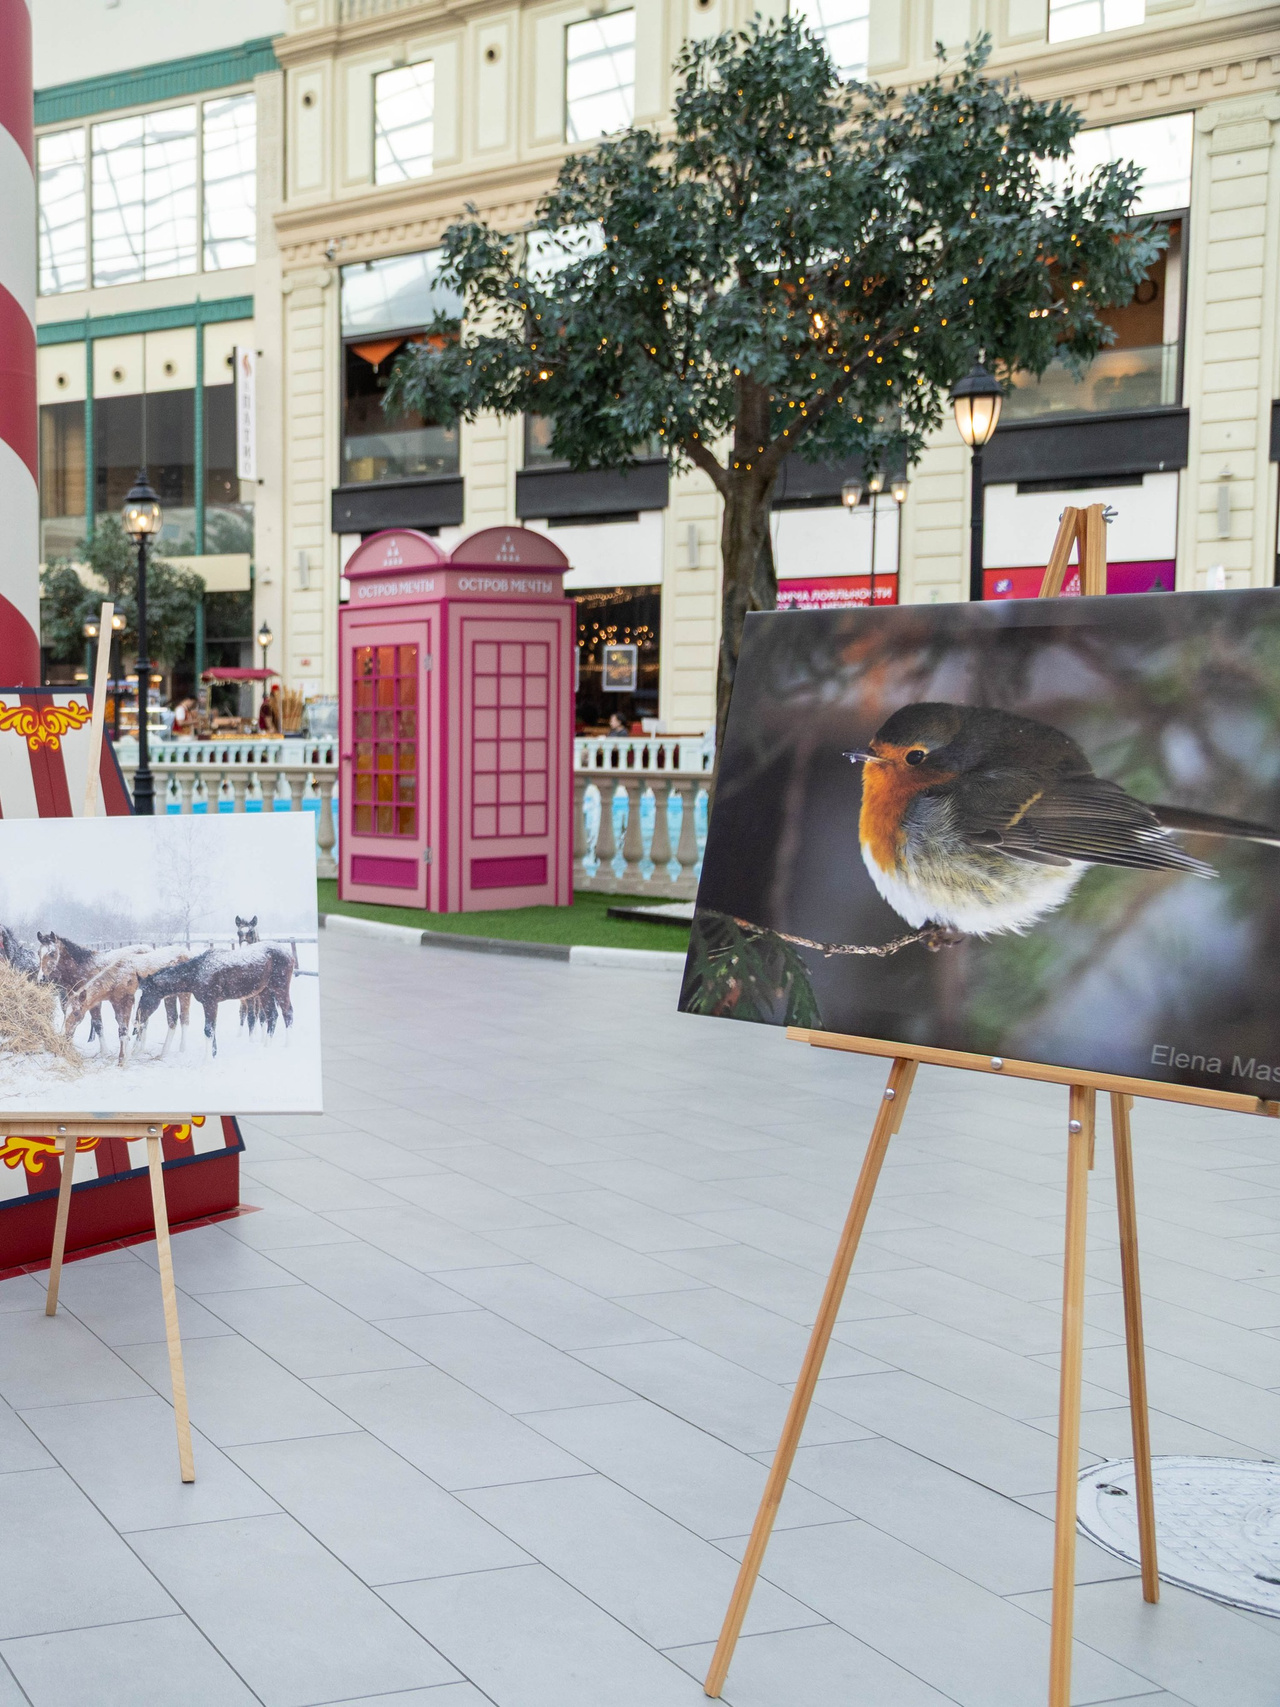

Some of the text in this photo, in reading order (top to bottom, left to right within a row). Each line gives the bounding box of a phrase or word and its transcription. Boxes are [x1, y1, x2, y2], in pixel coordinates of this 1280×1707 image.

[358, 579, 435, 599] ОСТРОВ МЕЧТЫ
[458, 577, 553, 593] ОСТРОВ МЕЧТЫ
[1150, 1044, 1222, 1074] Elena
